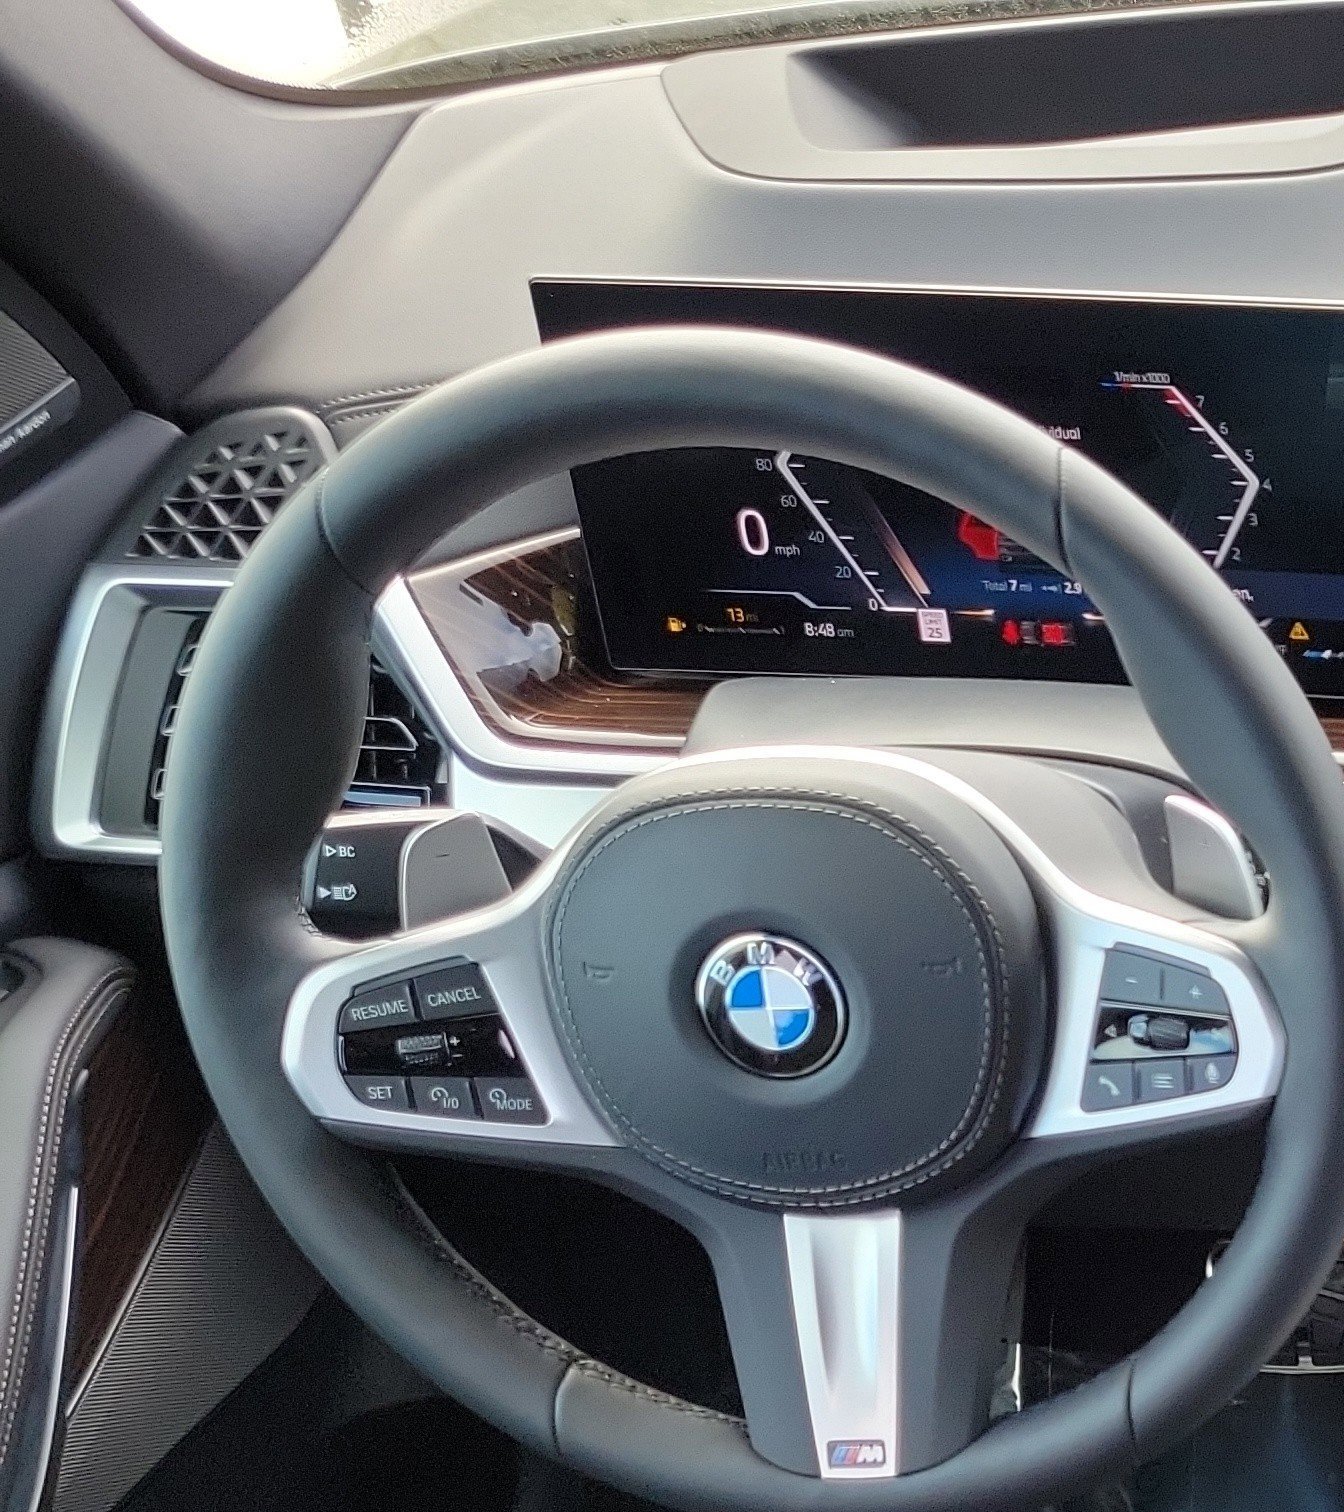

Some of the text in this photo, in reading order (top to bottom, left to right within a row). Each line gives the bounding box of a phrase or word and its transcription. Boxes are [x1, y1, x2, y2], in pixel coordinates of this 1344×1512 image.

[1219, 422, 1229, 435] 6
[1244, 449, 1254, 462] 5
[756, 458, 772, 471] 80
[780, 495, 797, 508] 60
[1248, 513, 1258, 526] 3
[737, 508, 800, 557] 0 mph
[808, 531, 824, 543] 40
[835, 566, 851, 578] 20
[1008, 579, 1018, 592] 7
[868, 599, 878, 611] 0
[803, 622, 835, 637] 8:48
[928, 627, 943, 639] 25
[339, 846, 356, 858] BC
[710, 941, 823, 987] BMW
[351, 987, 482, 1021] RESUME CANCEL
[368, 1086, 393, 1099] SET
[496, 1095, 533, 1111] MODE
